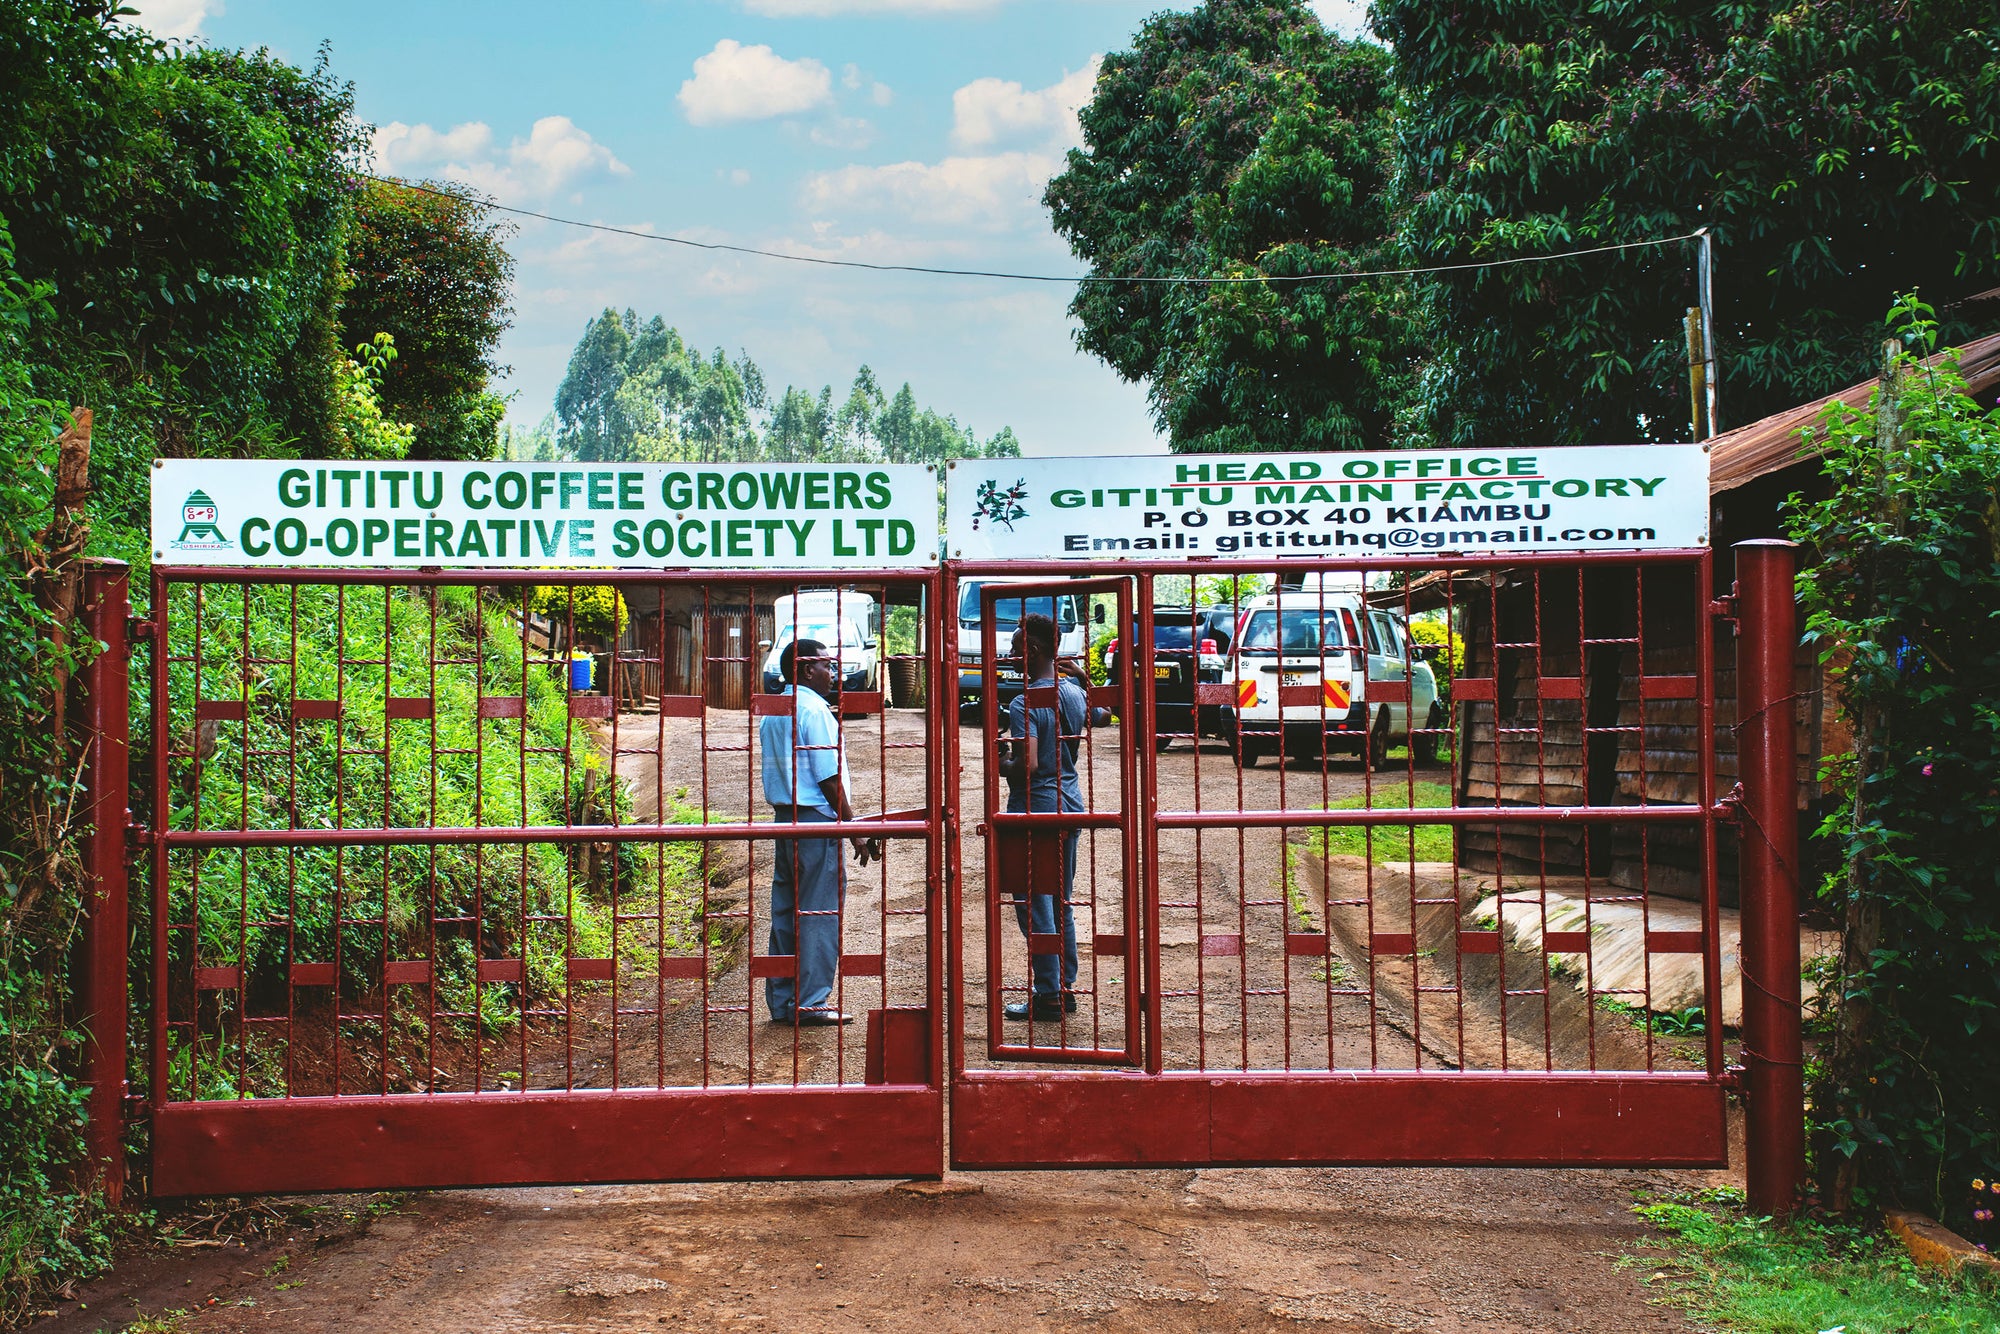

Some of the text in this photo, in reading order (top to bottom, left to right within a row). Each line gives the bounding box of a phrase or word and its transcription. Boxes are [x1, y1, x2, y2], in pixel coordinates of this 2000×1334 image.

[1175, 457, 1538, 482] HEAD OFFICE
[277, 468, 892, 511] GITITU COFFEE GROWERS
[1050, 477, 1668, 508] GITITU MAIN FACTORY
[1143, 503, 1552, 529] P.O BOX 40 KIAMBU
[240, 517, 916, 558] CO-OPERATIVE SOCIETY LTD
[1064, 526, 1656, 552] Email: gitituhq@gmail.com
